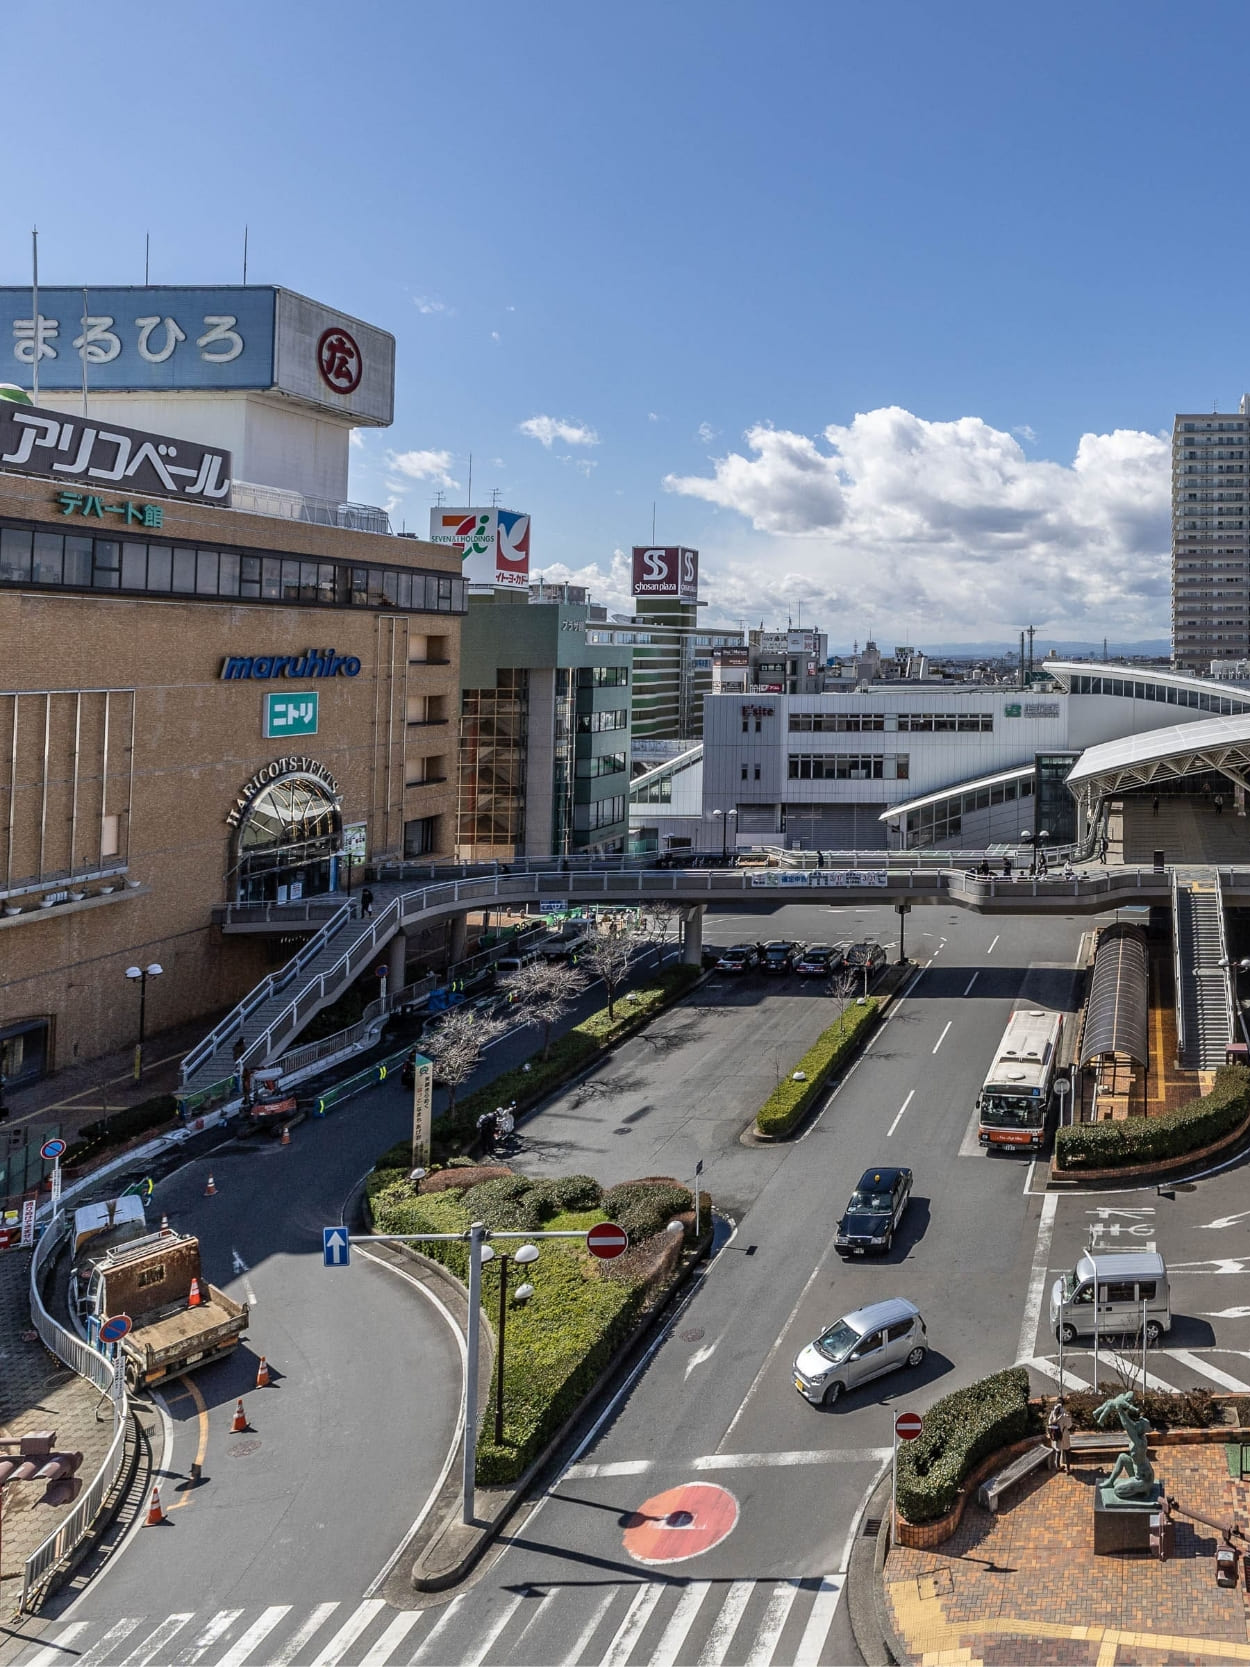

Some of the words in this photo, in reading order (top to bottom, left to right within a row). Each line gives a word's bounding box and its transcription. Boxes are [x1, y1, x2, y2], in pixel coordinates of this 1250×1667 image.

[13, 315, 244, 364] まるひろ
[2, 412, 230, 498] アリコベール
[57, 490, 164, 529] デパート館
[660, 581, 677, 592] plaza
[221, 648, 361, 680] maruhiro
[272, 702, 314, 726] ニトリ
